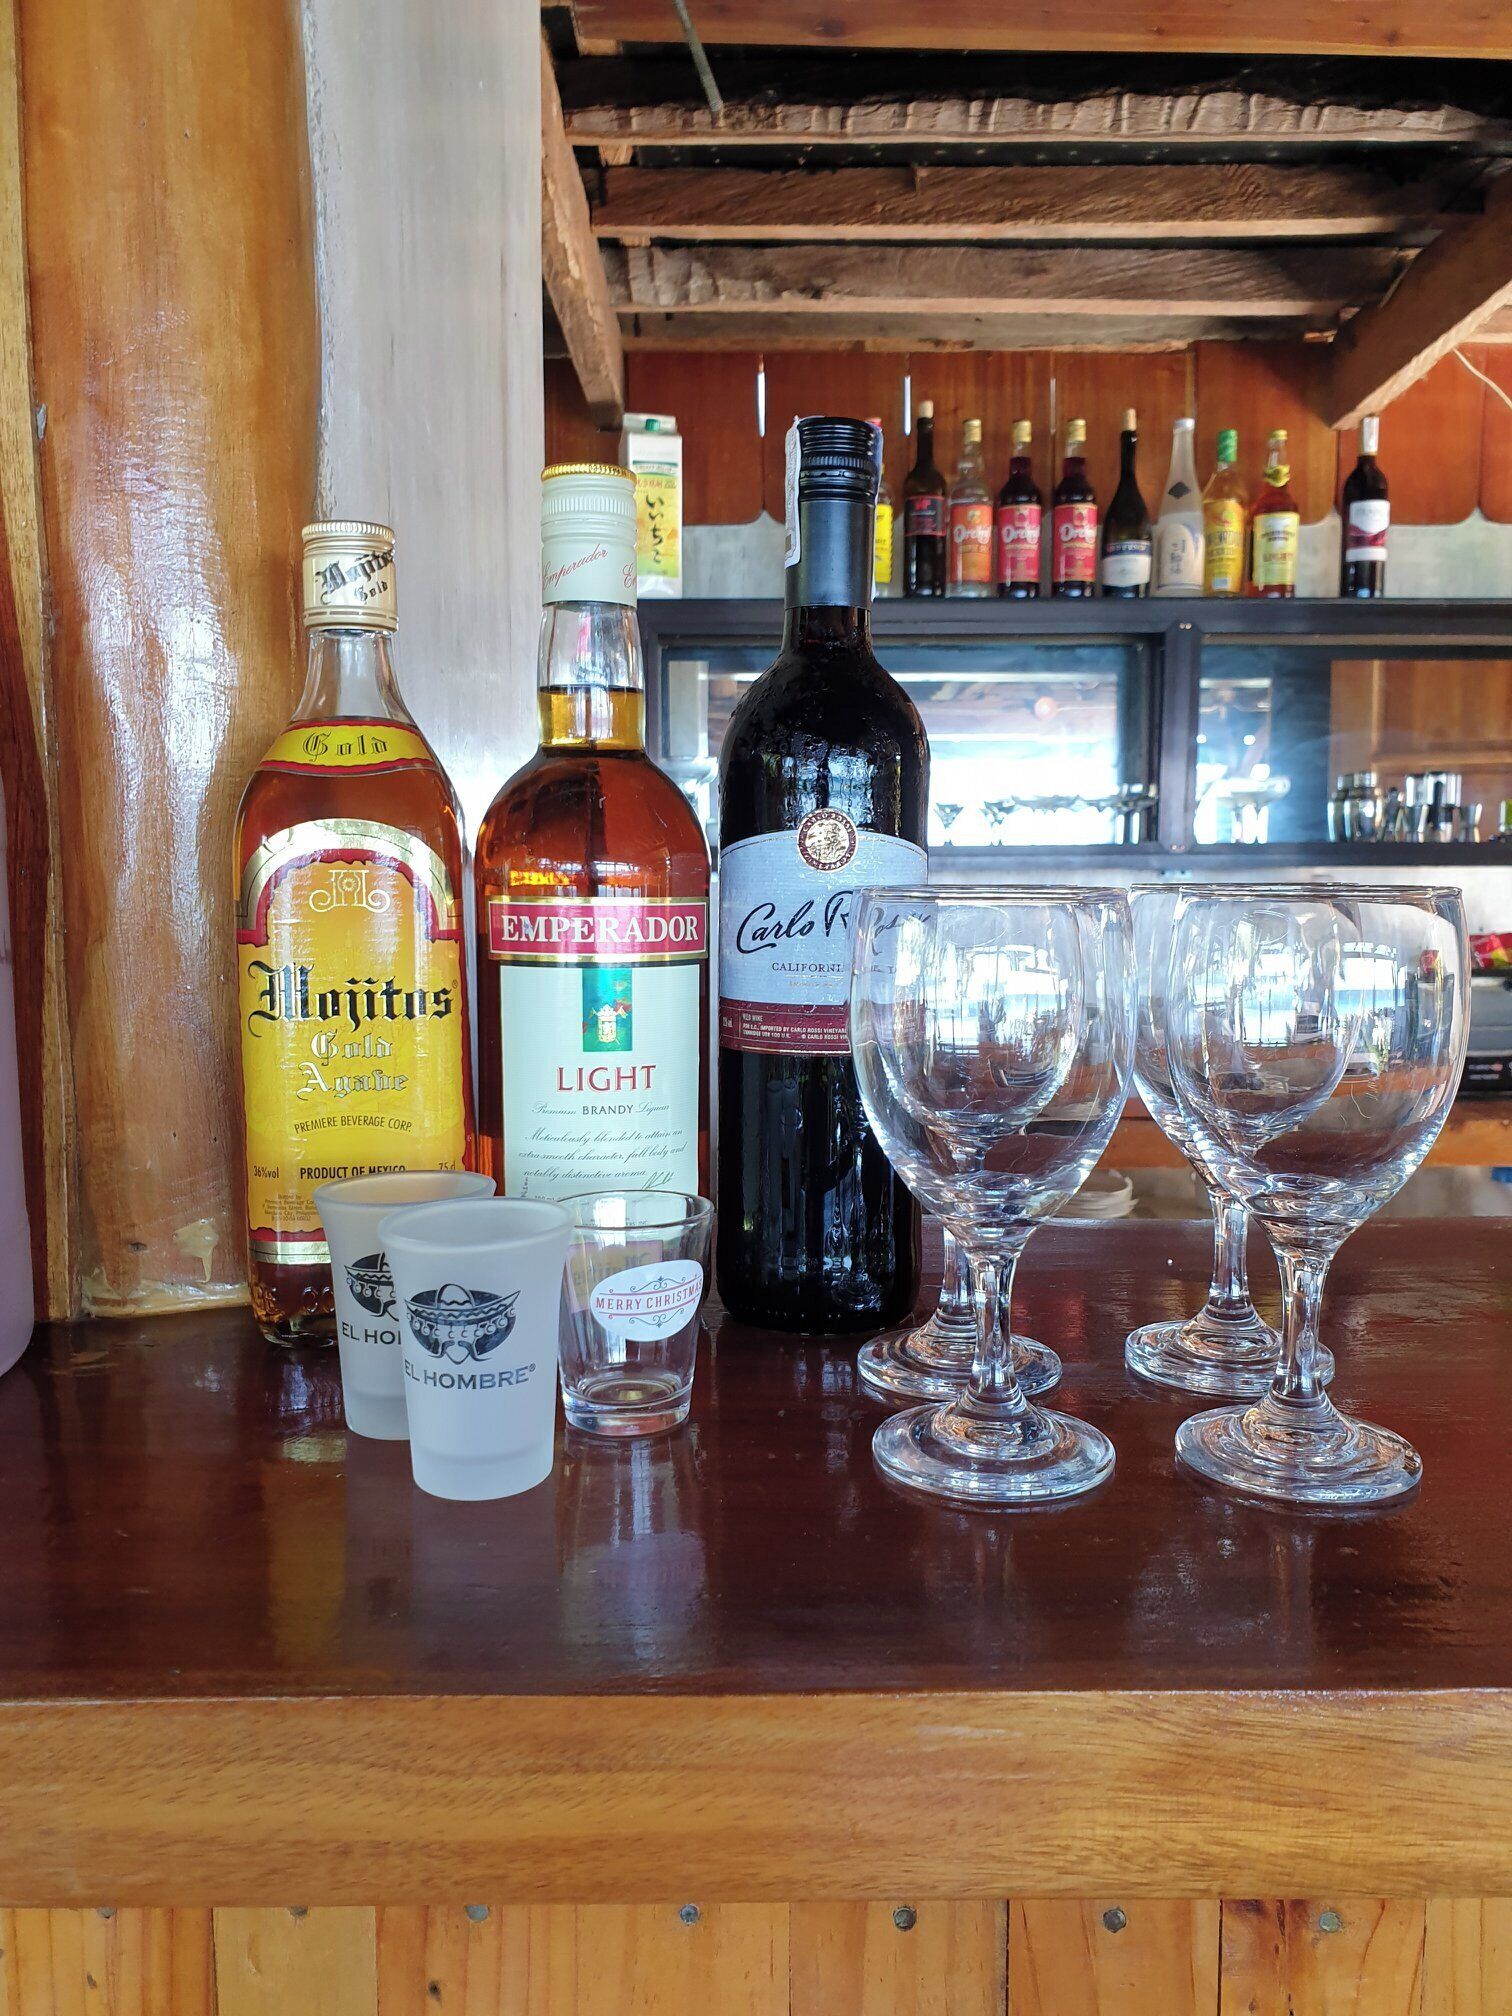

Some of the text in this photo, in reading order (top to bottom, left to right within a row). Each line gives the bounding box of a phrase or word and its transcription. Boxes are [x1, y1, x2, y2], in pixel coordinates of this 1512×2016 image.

[302, 731, 388, 762] Gold
[501, 915, 699, 943] EMPERADOR
[737, 900, 815, 954] Carlo
[310, 1030, 393, 1066] Gold
[556, 1065, 657, 1092] LIGHT
[532, 1101, 670, 1116] Premium BRANDY Liqueur
[294, 1115, 413, 1134] PREMIERE BEVERAGE CORP.
[525, 1127, 591, 1146] Meticulously
[594, 1129, 633, 1143] blended
[634, 1131, 643, 1140] to
[645, 1130, 671, 1140] attain
[518, 1151, 541, 1159] extra
[542, 1149, 575, 1160] smooth
[624, 1146, 647, 1163] full
[649, 1144, 669, 1158] body
[670, 1141, 688, 1153] and
[300, 1166, 349, 1179] PRODUCT
[351, 1166, 365, 1177] OF
[523, 1166, 559, 1181] notably
[561, 1167, 612, 1180] distinctive
[596, 1297, 642, 1310] MERRY
[342, 1321, 359, 1341] EL
[404, 1358, 421, 1381] EL
